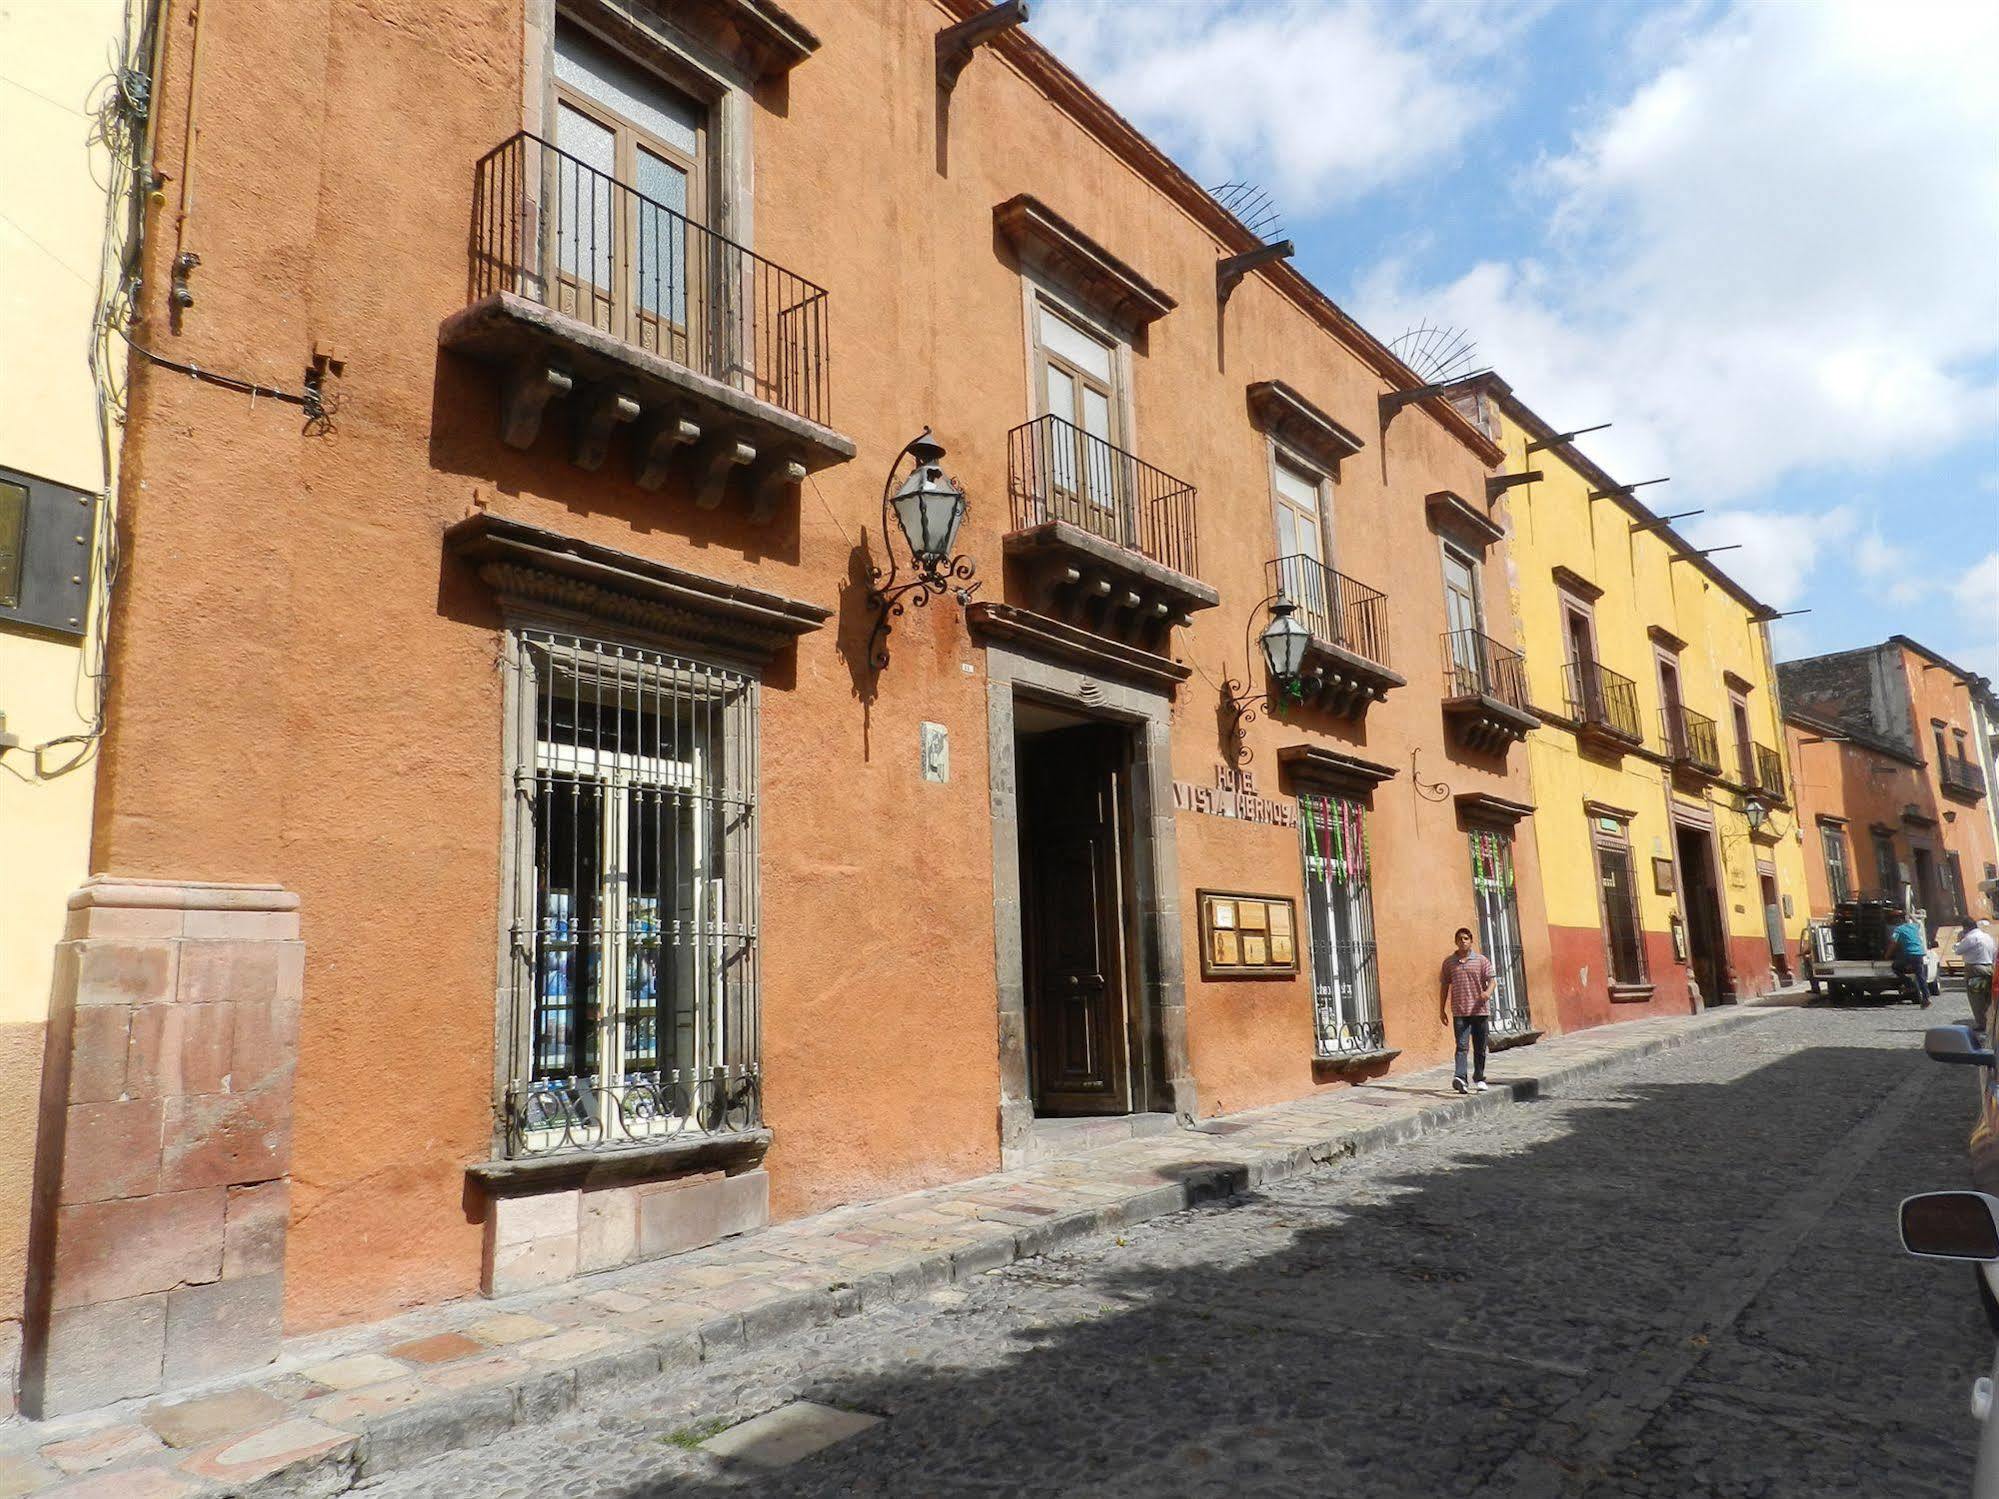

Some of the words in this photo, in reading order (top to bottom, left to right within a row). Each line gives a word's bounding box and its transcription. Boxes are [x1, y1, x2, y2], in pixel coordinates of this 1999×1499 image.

[1215, 764, 1258, 797] HOTEL
[1173, 781, 1226, 818] VISTA
[1235, 793, 1298, 829] HERMOSA
